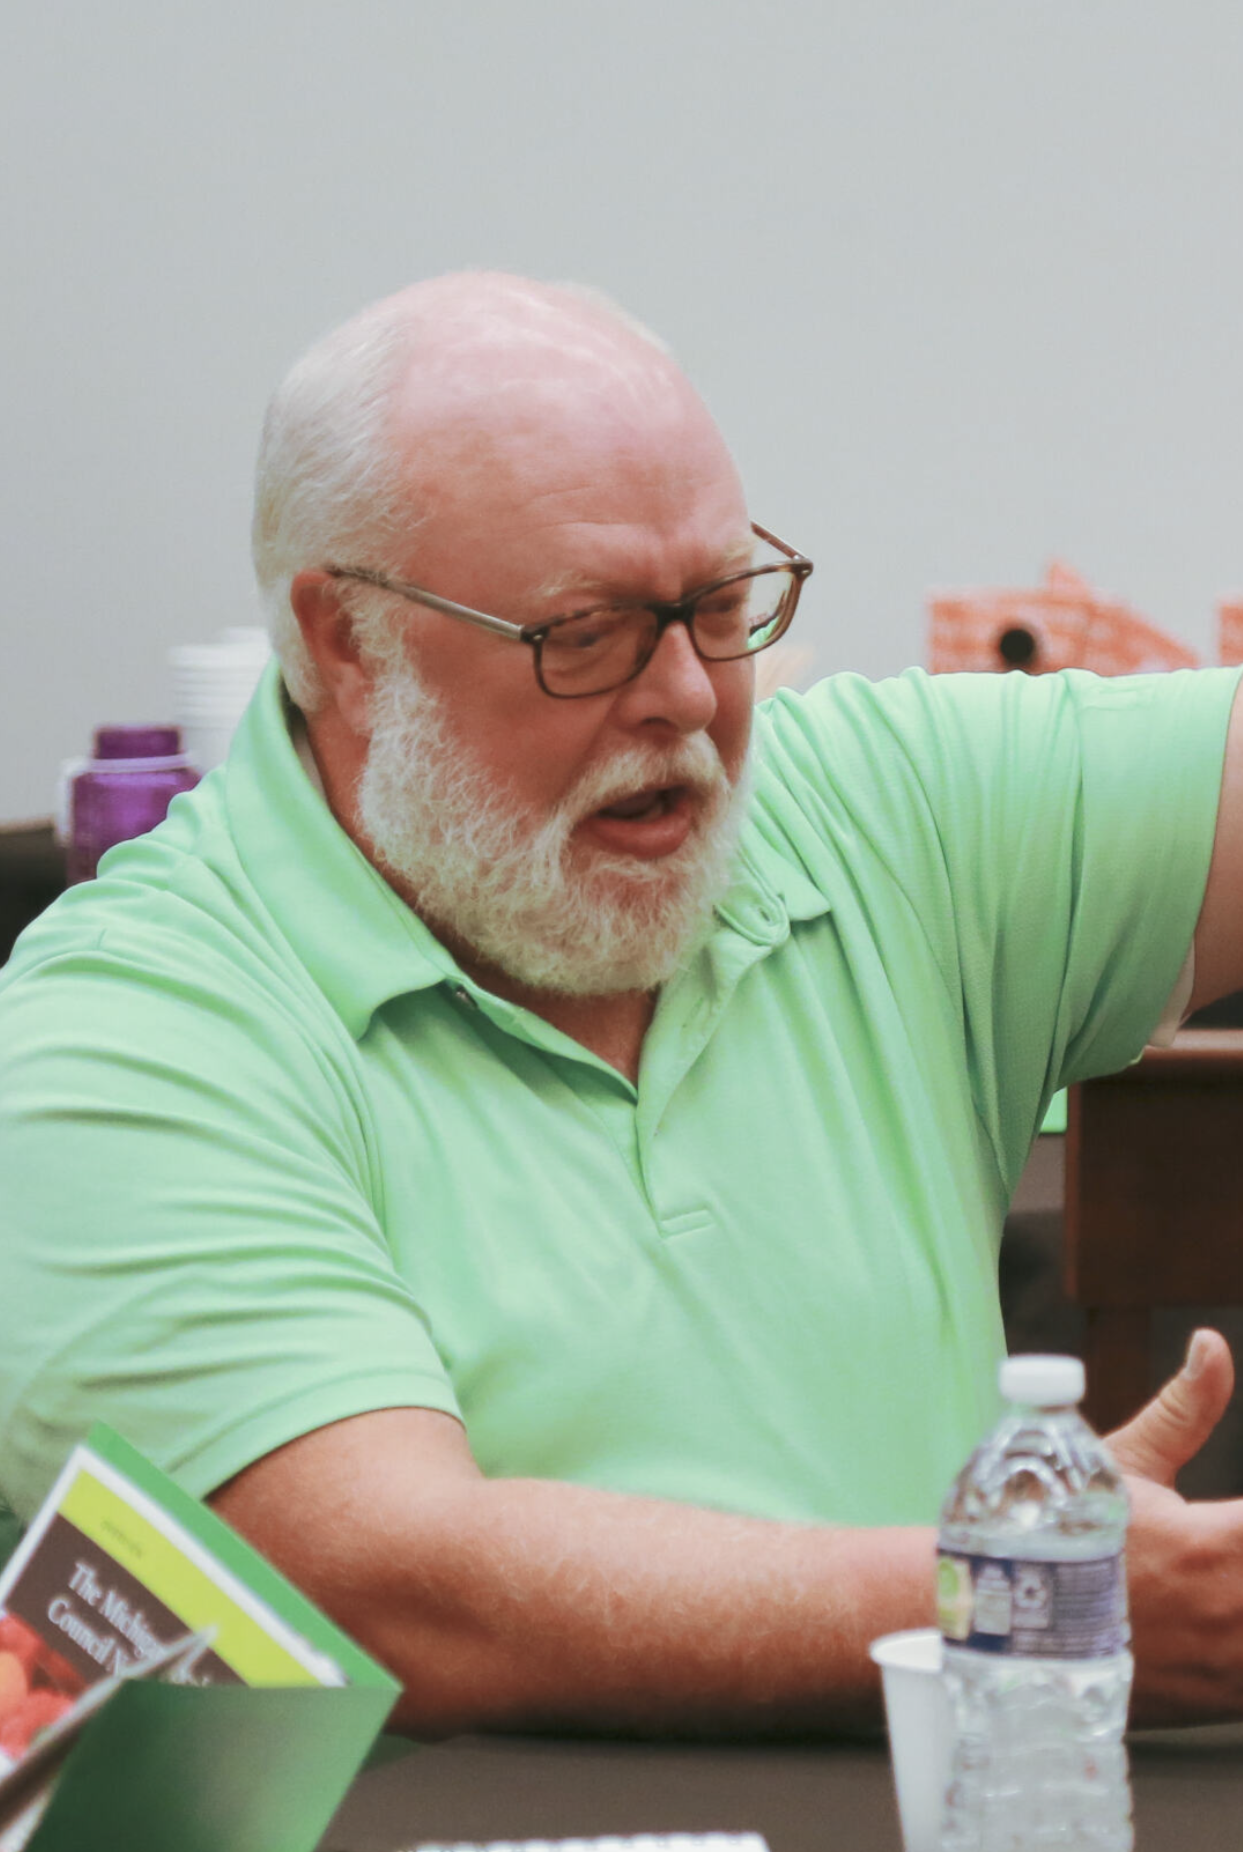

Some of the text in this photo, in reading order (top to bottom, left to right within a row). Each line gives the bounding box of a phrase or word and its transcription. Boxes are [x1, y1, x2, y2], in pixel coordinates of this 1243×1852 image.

[47, 1595, 116, 1665] Council
[68, 1561, 164, 1660] The Michig
